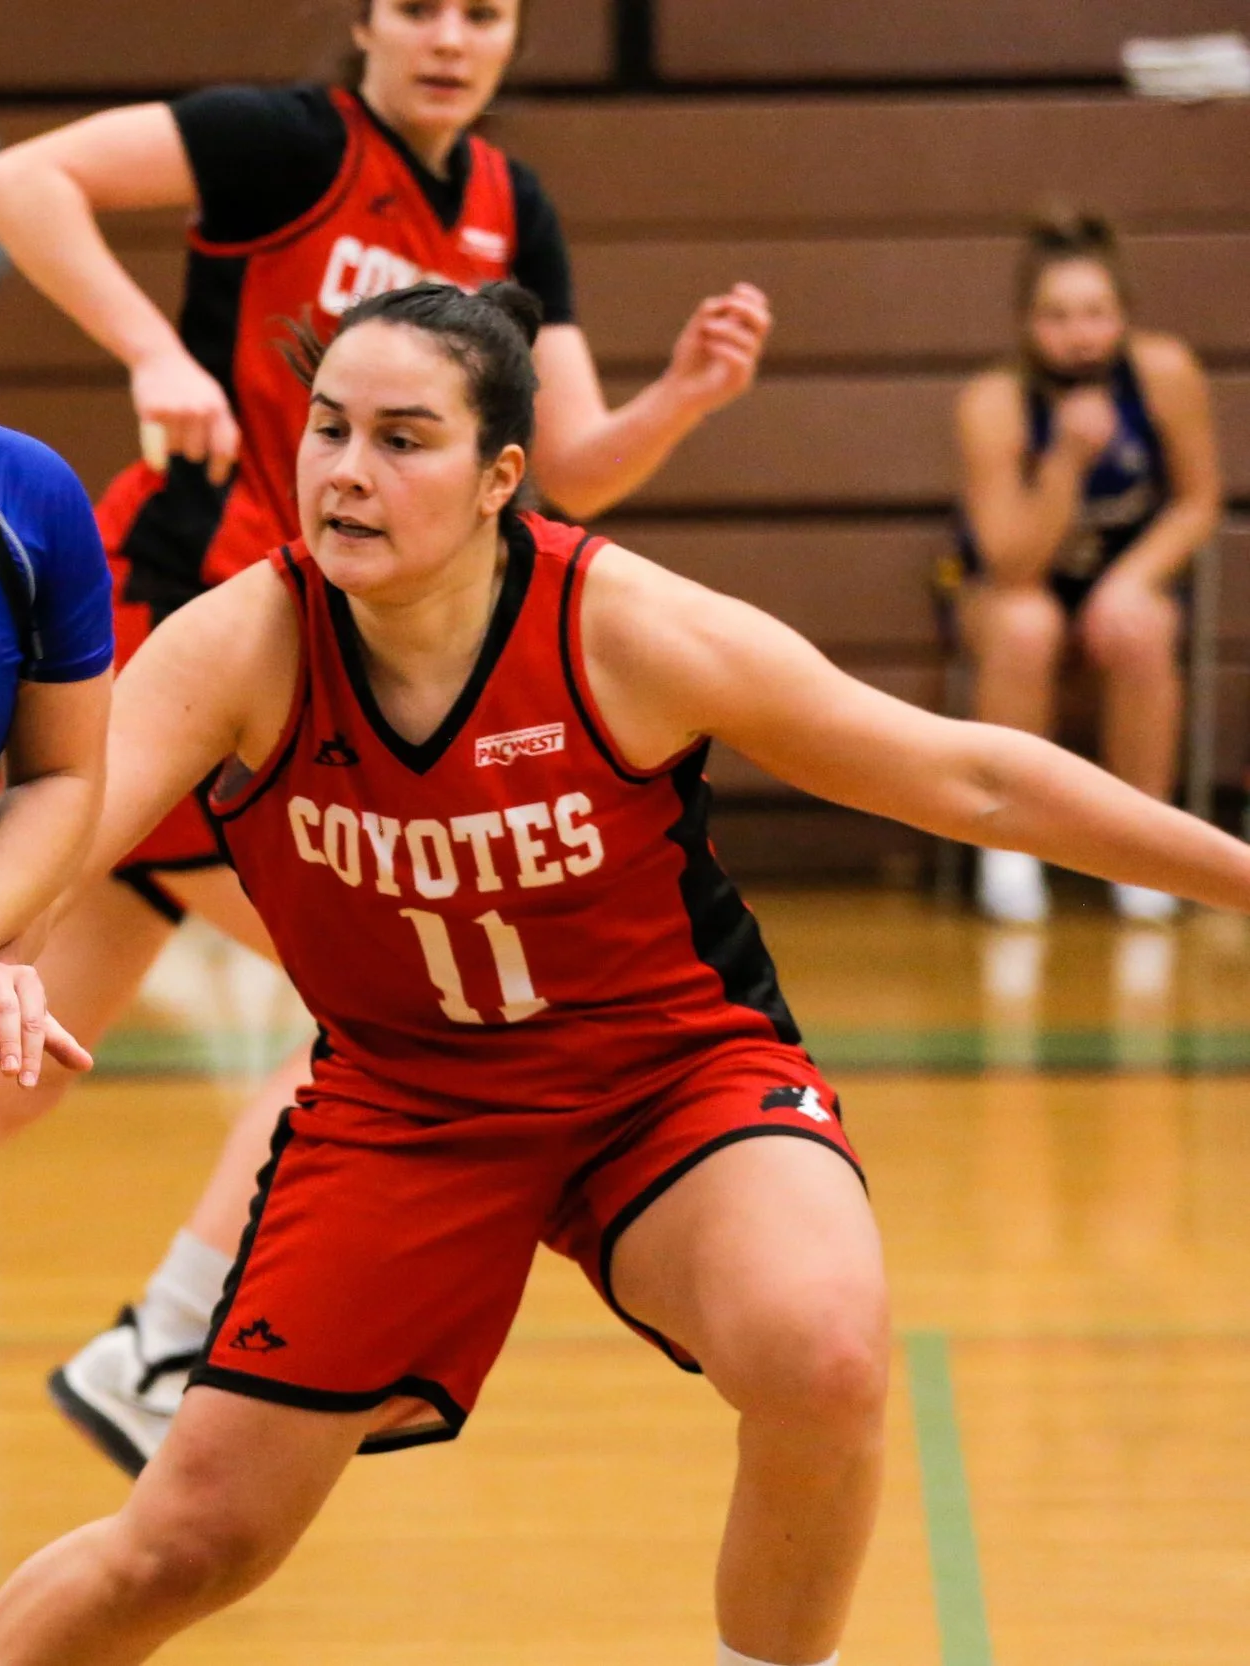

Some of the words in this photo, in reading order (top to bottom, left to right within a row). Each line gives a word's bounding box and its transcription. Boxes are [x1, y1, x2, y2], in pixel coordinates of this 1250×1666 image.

[477, 731, 563, 765] PACWEST
[287, 791, 605, 900] COYOTES
[398, 907, 550, 1025] 11
